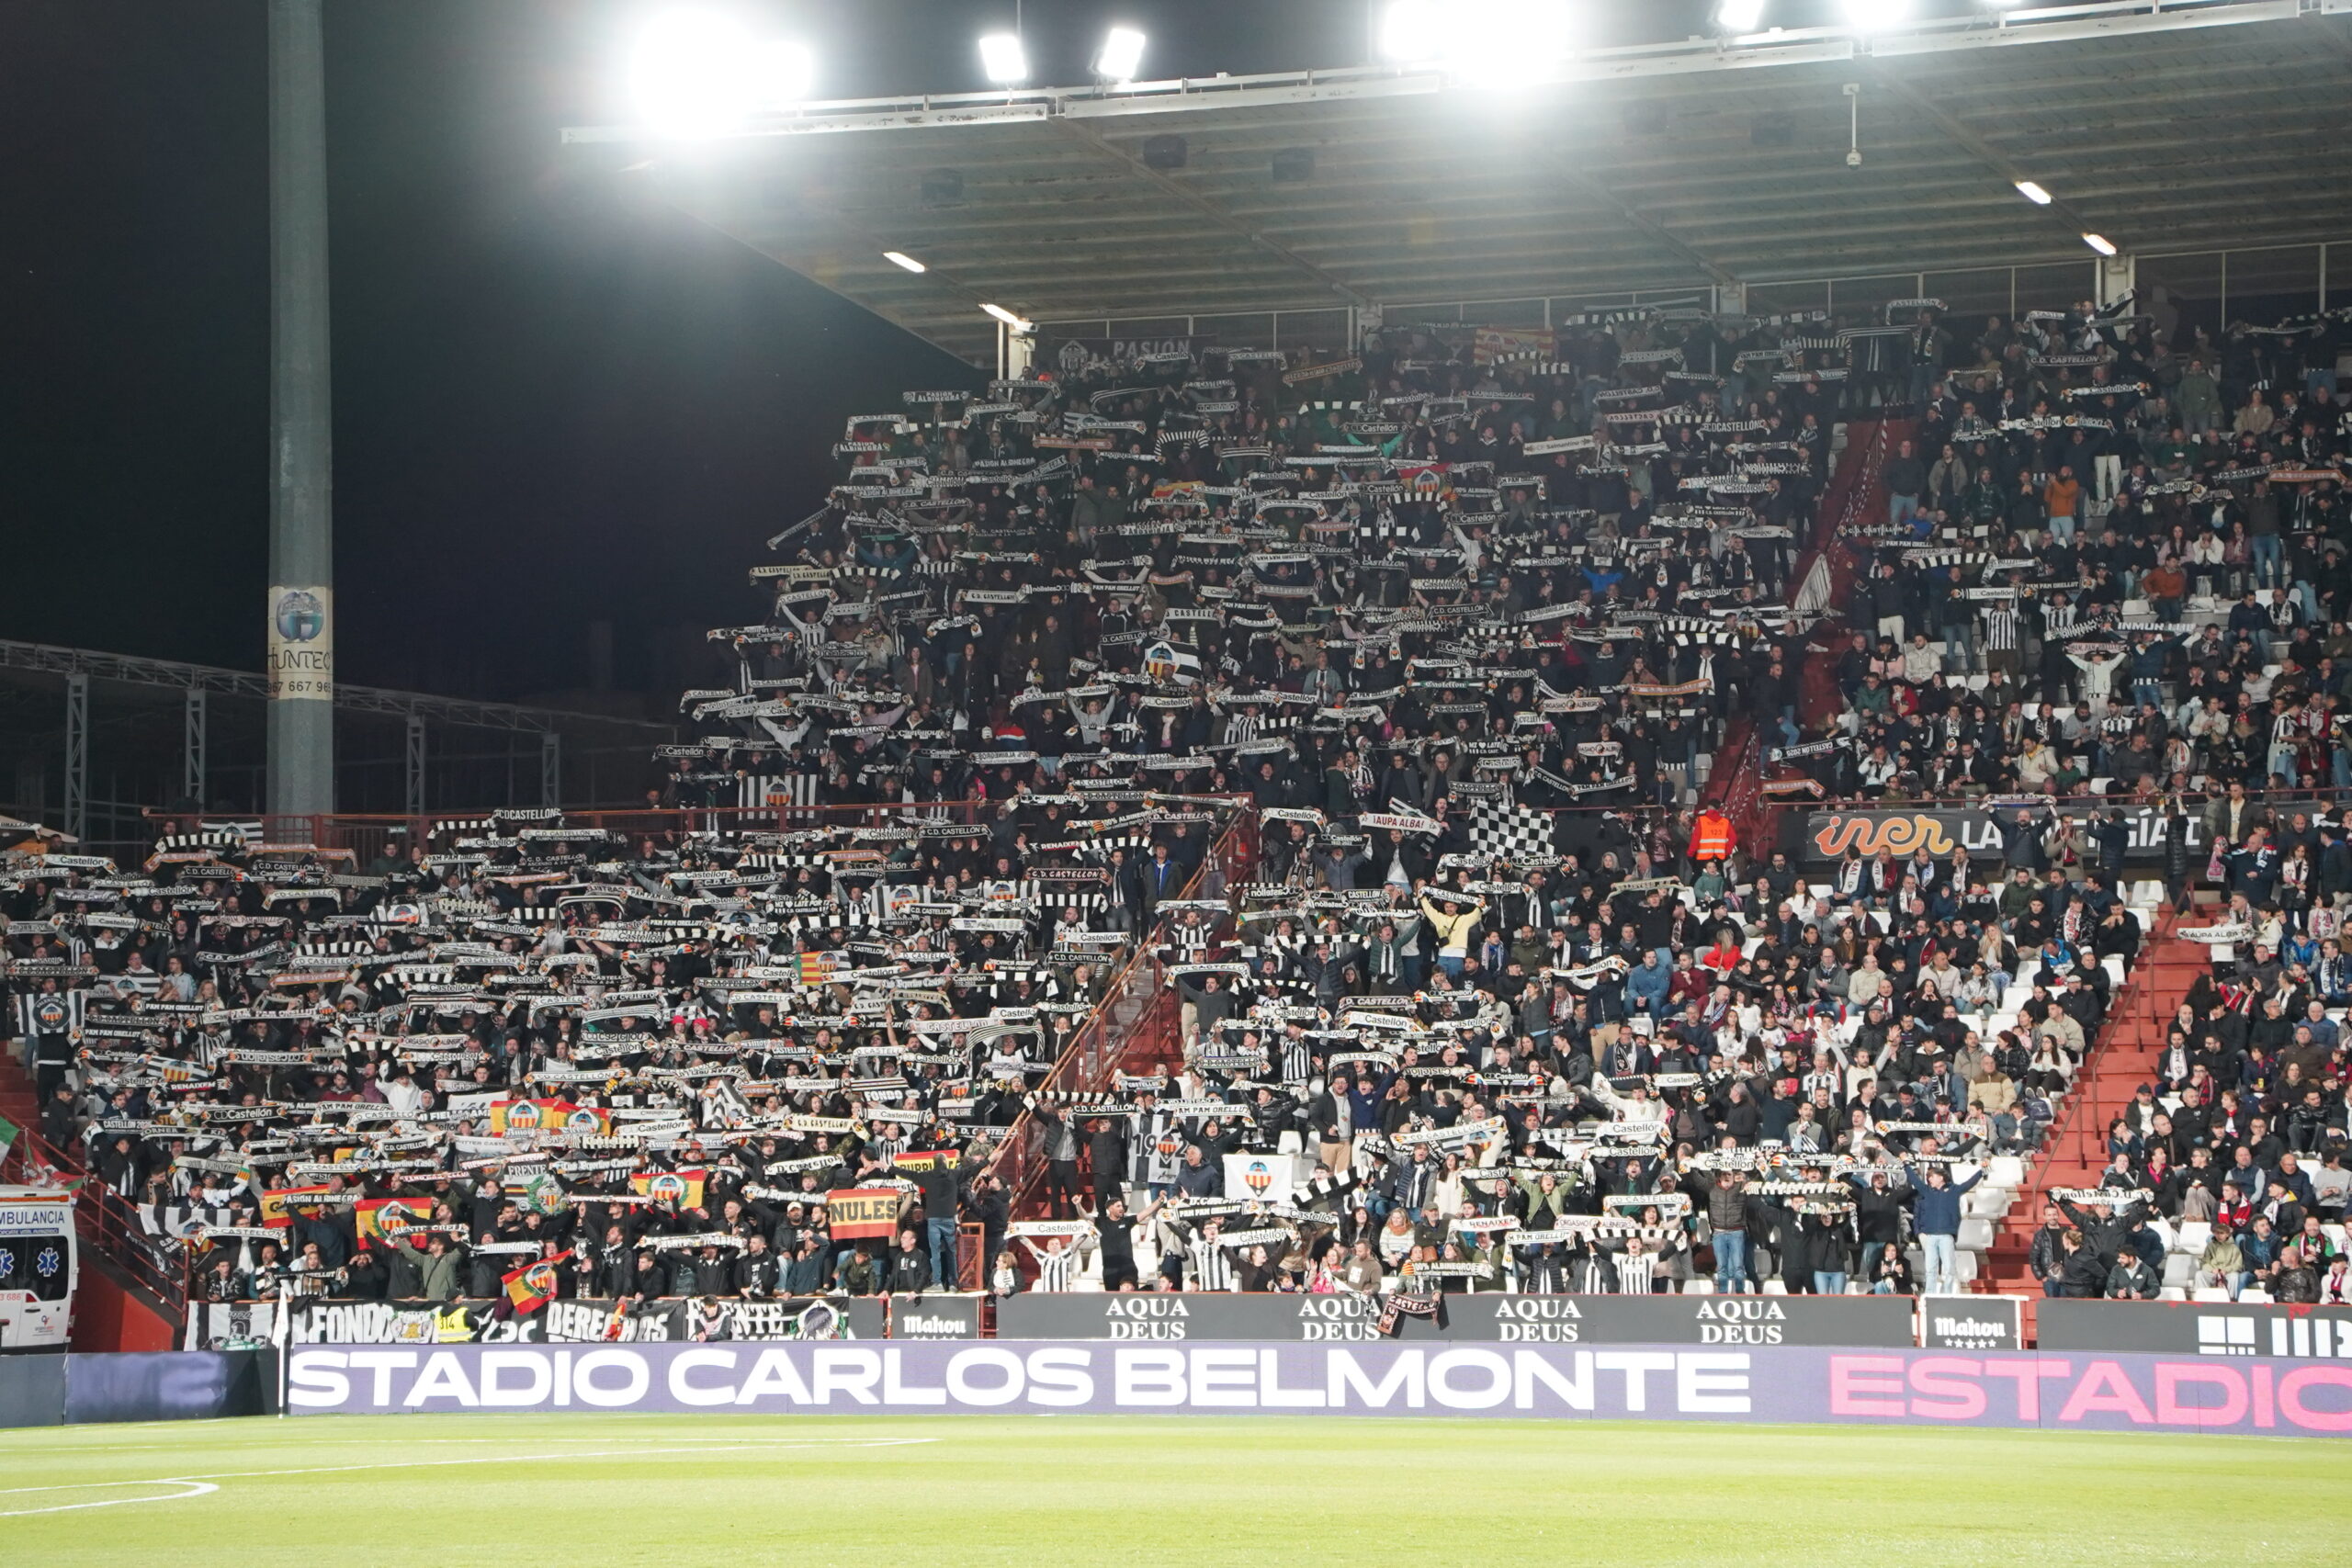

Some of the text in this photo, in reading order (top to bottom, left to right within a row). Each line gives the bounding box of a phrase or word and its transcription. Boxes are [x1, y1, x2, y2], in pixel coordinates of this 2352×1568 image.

[289, 682, 311, 692] 667
[1277, 809, 1317, 820] Castellón
[1041, 841, 1081, 850] RENAIXE
[735, 924, 778, 934] Castellón
[1080, 933, 1118, 942] Castellón
[865, 1091, 902, 1101] FONDO
[639, 1121, 684, 1132] Castellón
[509, 1164, 546, 1176] FRENTE
[831, 1201, 896, 1221] NULES
[1038, 1223, 1083, 1233] Castellón
[1106, 1298, 1189, 1315] AQUA
[1298, 1298, 1380, 1317] AQUA
[1496, 1300, 1581, 1317] AQUA
[1698, 1302, 1785, 1319] AQUA
[904, 1316, 966, 1333] Mahou
[1110, 1323, 1185, 1339] DEUS
[1303, 1323, 1380, 1341] DEUS
[1935, 1317, 2005, 1337] Mahou
[1499, 1325, 1578, 1341] DEUS
[1702, 1325, 1781, 1343] DEUS
[288, 1348, 1751, 1414] STADIO CARLOS BELMONTE
[1829, 1355, 2352, 1430] ESTADIO
